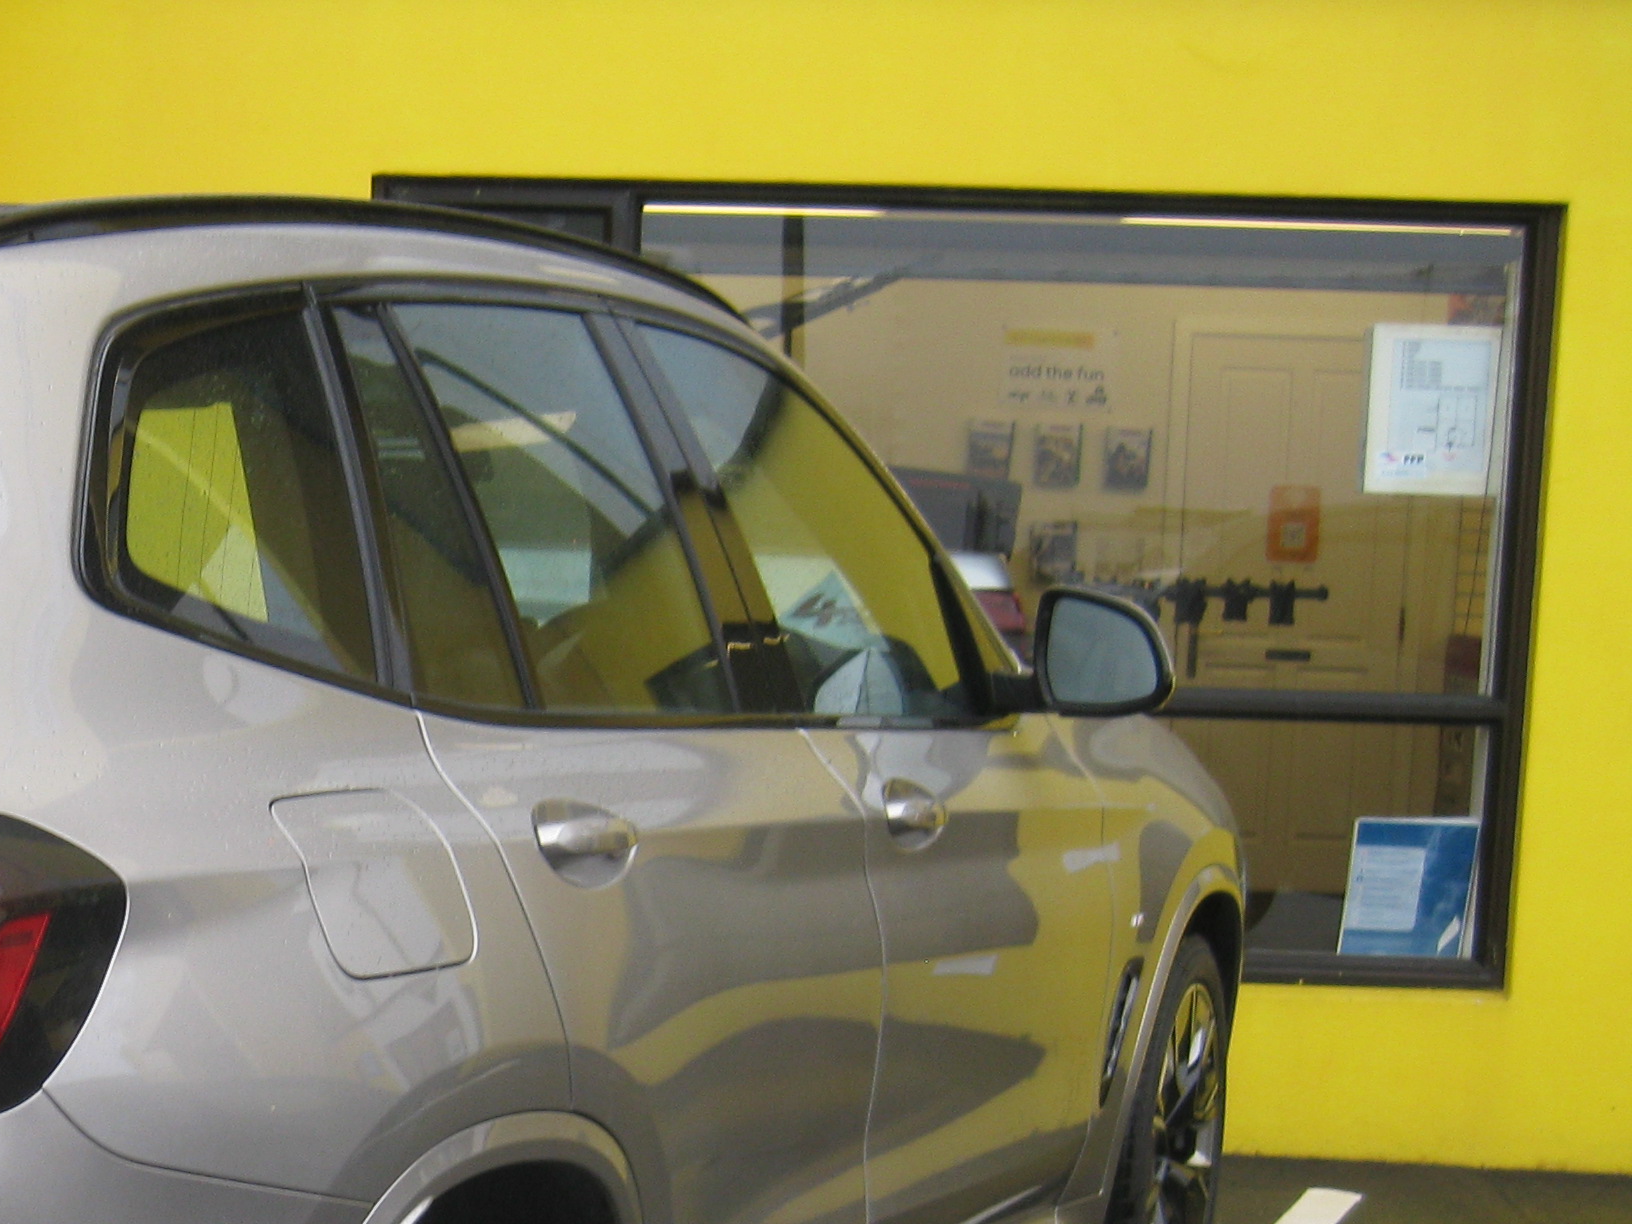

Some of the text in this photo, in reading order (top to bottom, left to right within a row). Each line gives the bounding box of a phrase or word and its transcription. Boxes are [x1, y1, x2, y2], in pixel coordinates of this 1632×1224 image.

[1009, 365, 1105, 380] add the fun
